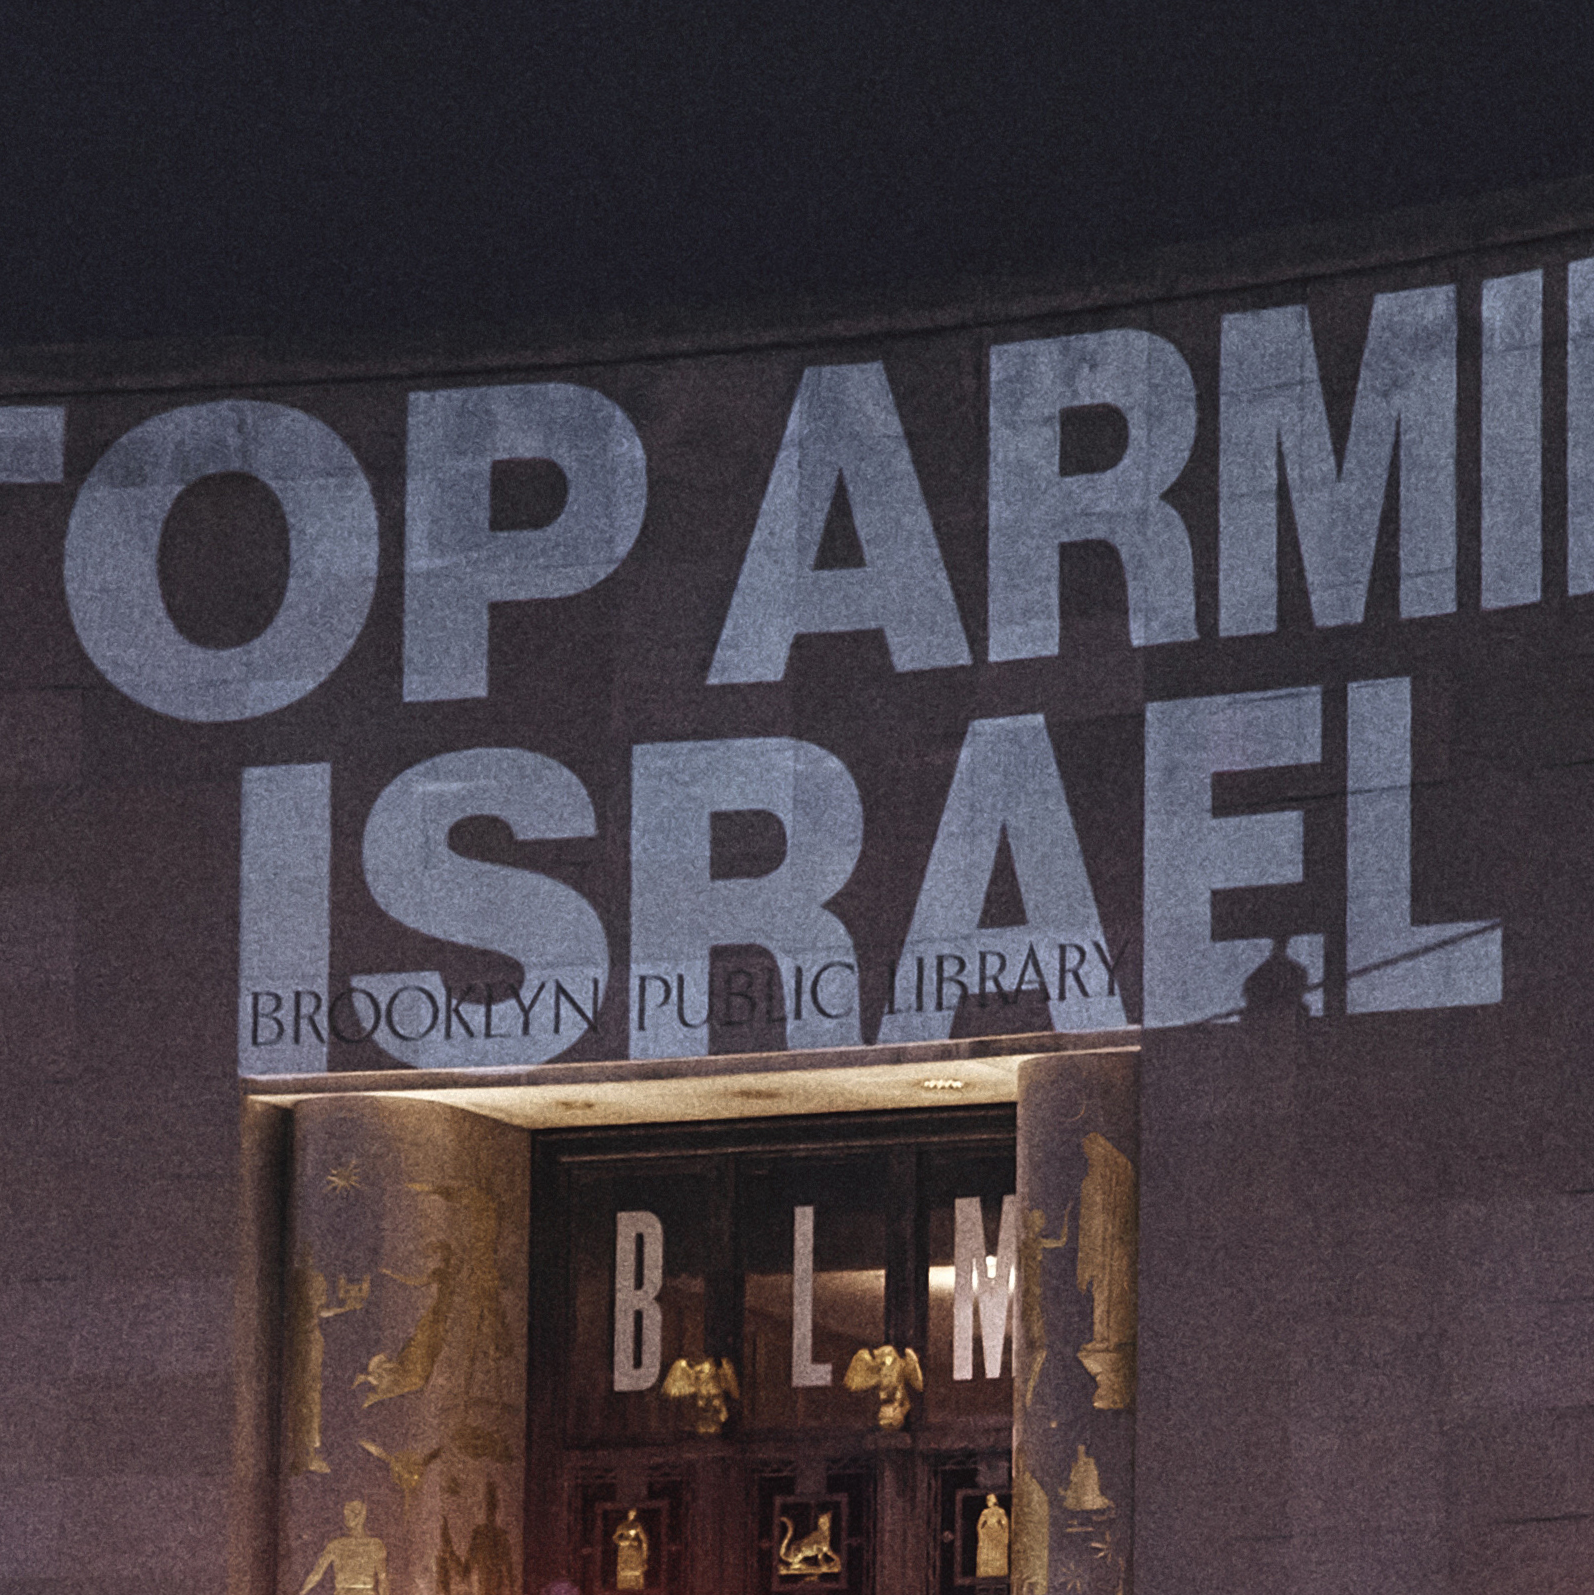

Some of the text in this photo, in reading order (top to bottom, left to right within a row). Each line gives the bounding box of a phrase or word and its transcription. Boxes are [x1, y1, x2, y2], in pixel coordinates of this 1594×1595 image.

[239, 675, 1504, 1078] ISRAEL
[249, 940, 1133, 1049] BROOKLYN PUBLIC LIBRARY
